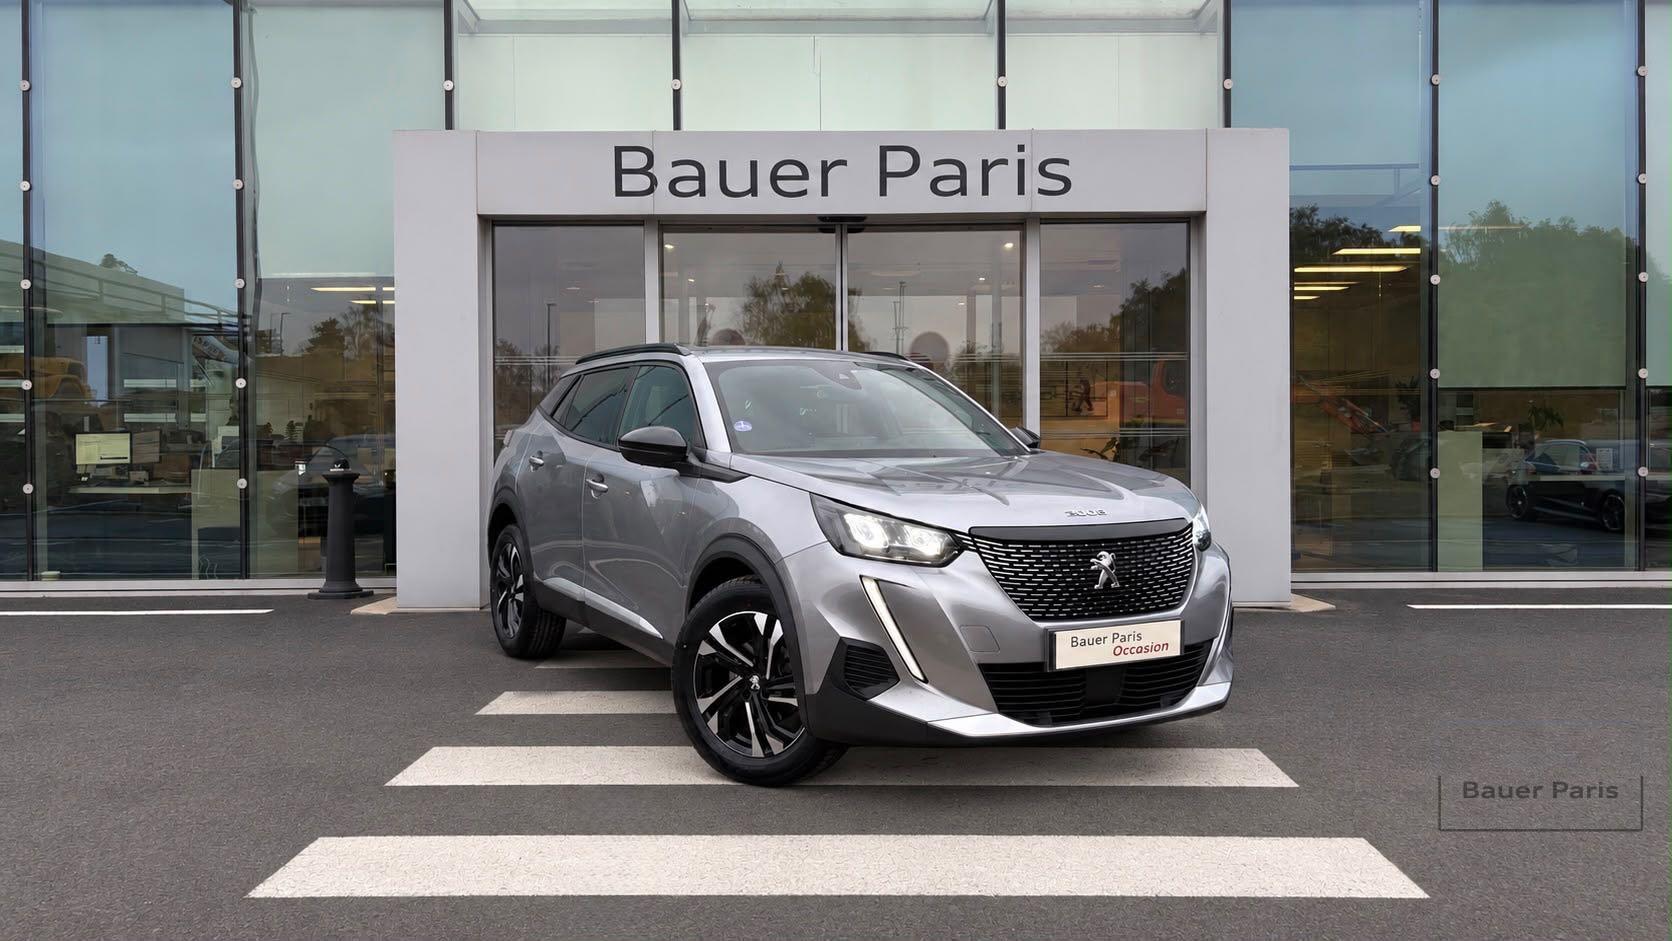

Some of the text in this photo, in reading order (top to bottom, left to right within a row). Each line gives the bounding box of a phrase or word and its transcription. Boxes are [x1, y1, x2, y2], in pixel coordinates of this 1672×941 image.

[614, 144, 1073, 198] Bauer Paris
[1071, 632, 1142, 647] Bauer Paris
[1113, 642, 1169, 656] Occasion
